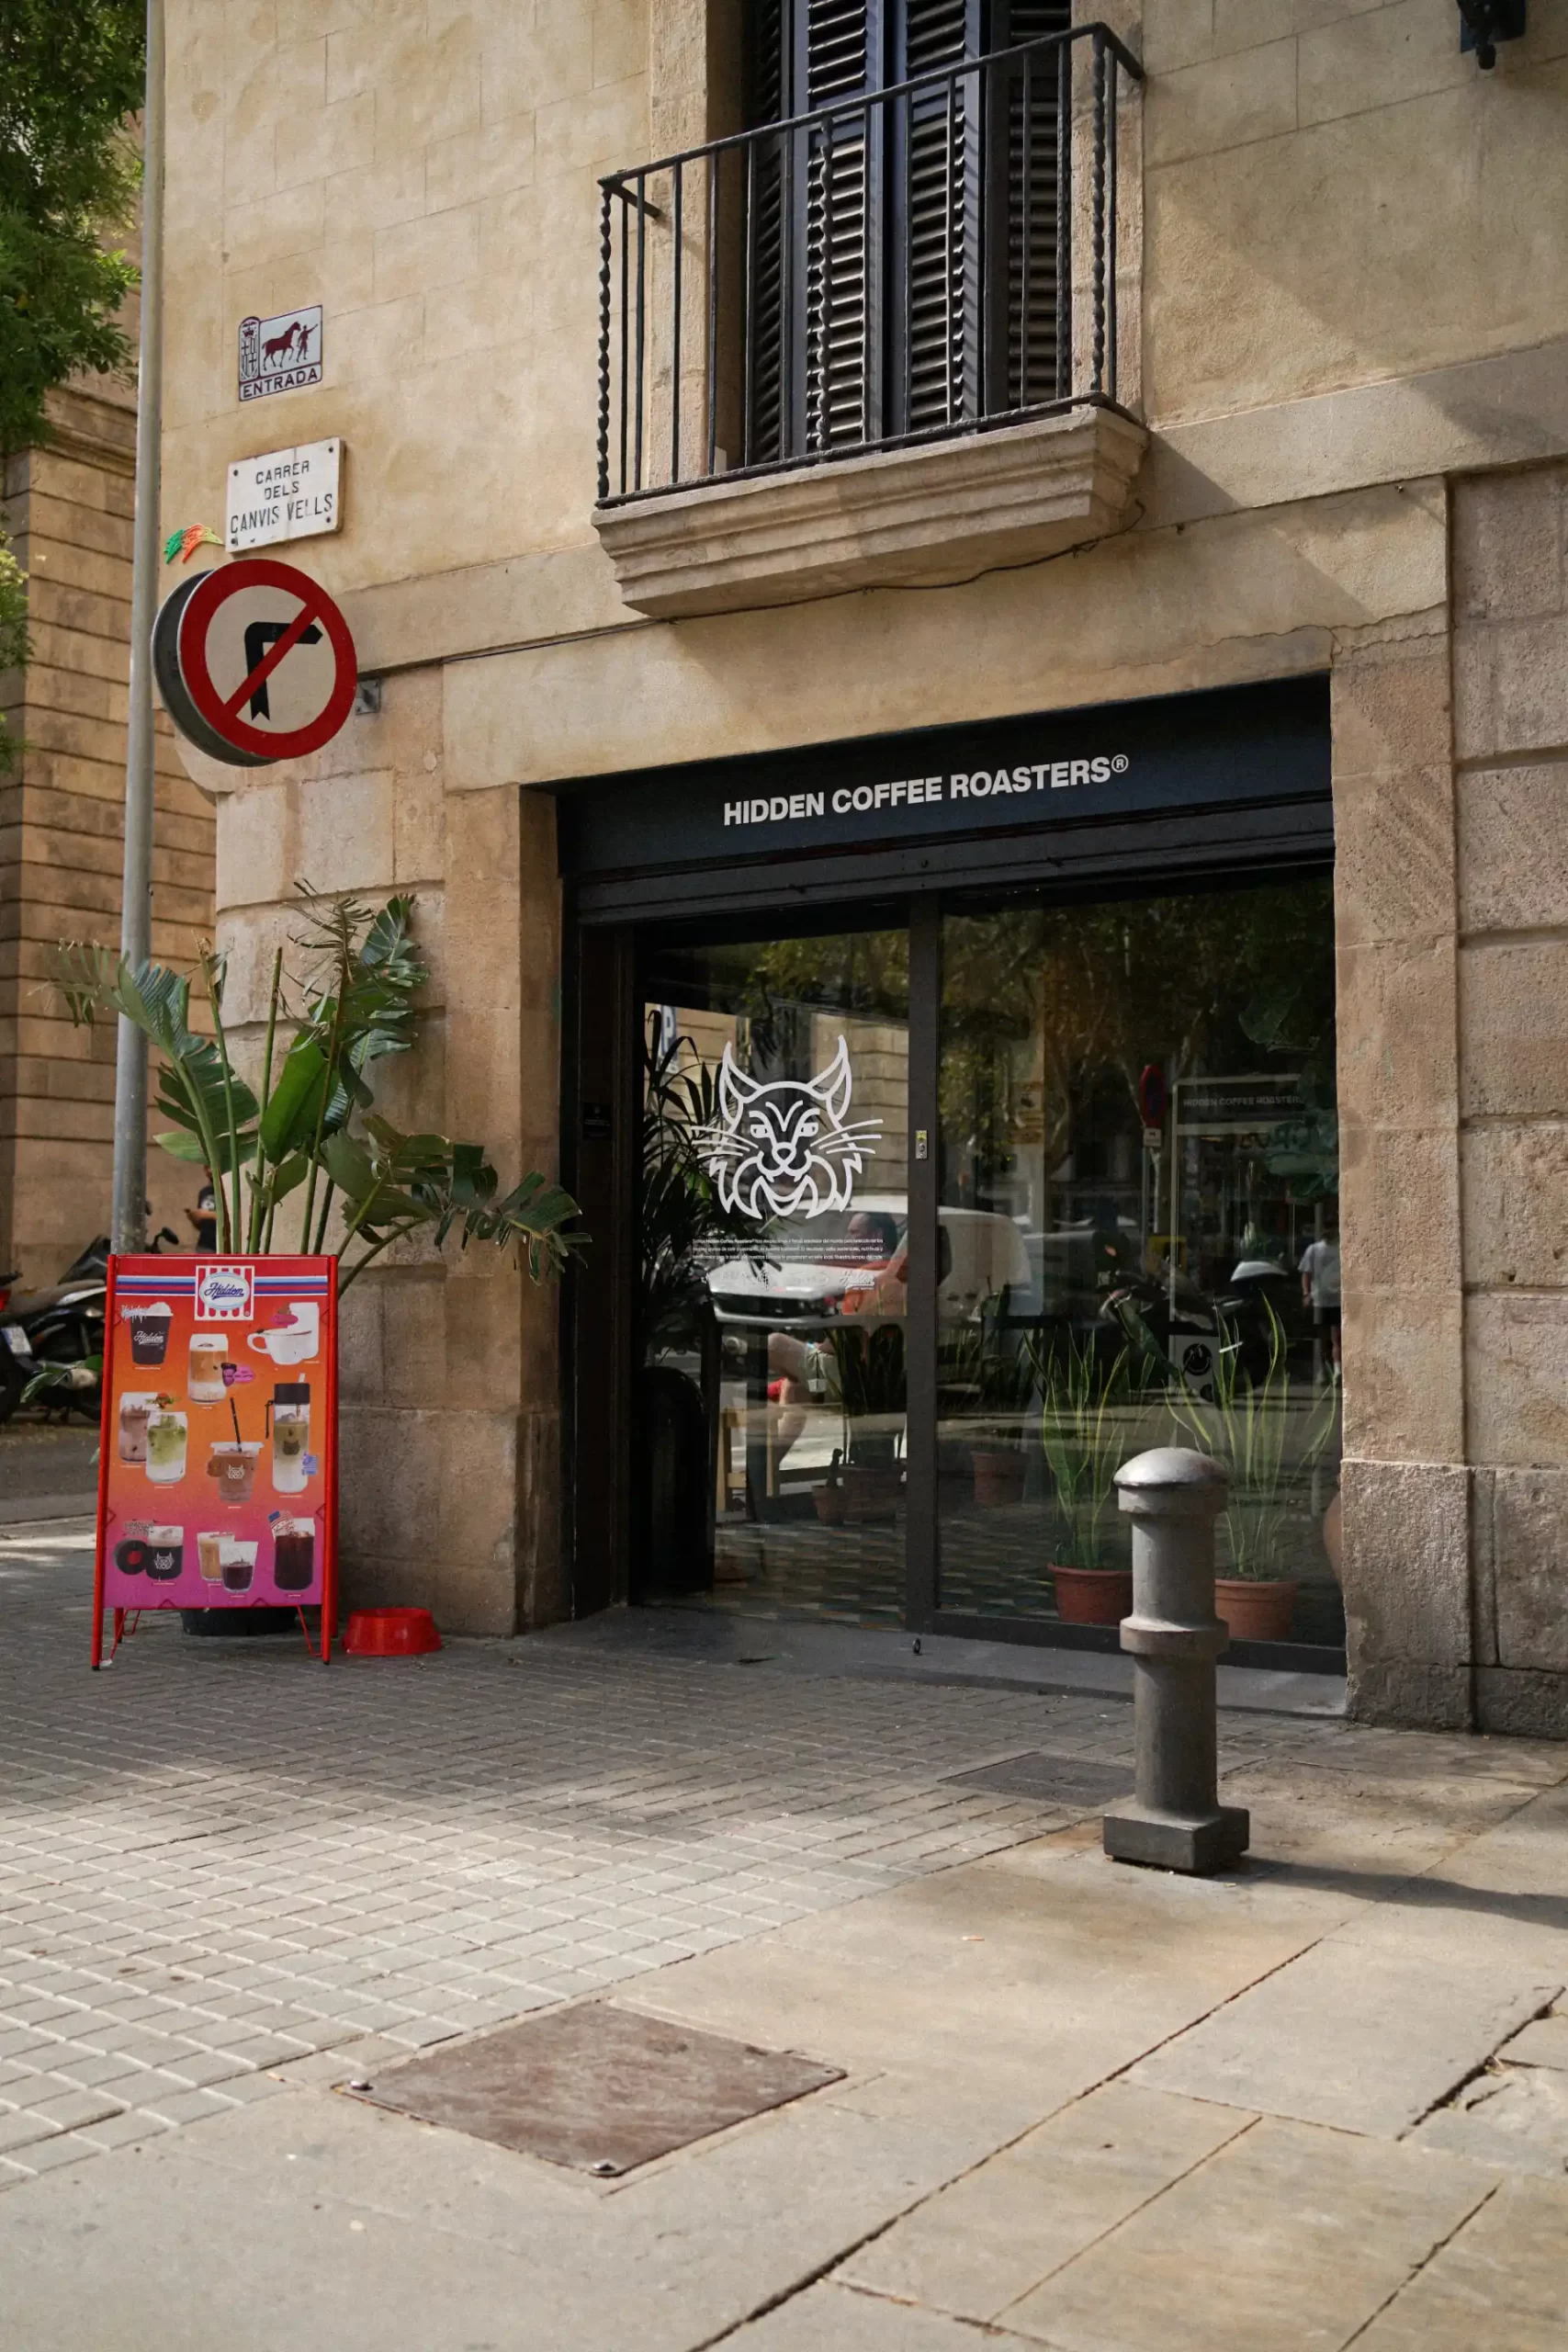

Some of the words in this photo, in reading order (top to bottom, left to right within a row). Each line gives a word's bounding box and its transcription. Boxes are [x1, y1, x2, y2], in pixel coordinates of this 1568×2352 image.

[243, 368, 318, 400] ENTRADA
[255, 460, 310, 485] CARRER
[265, 481, 299, 501] DELS
[231, 505, 279, 534] CANVIS
[288, 493, 333, 522] VELLS
[724, 792, 825, 826] HIDDEN
[831, 776, 942, 814] COFFEE
[204, 1282, 244, 1301] Hidden
